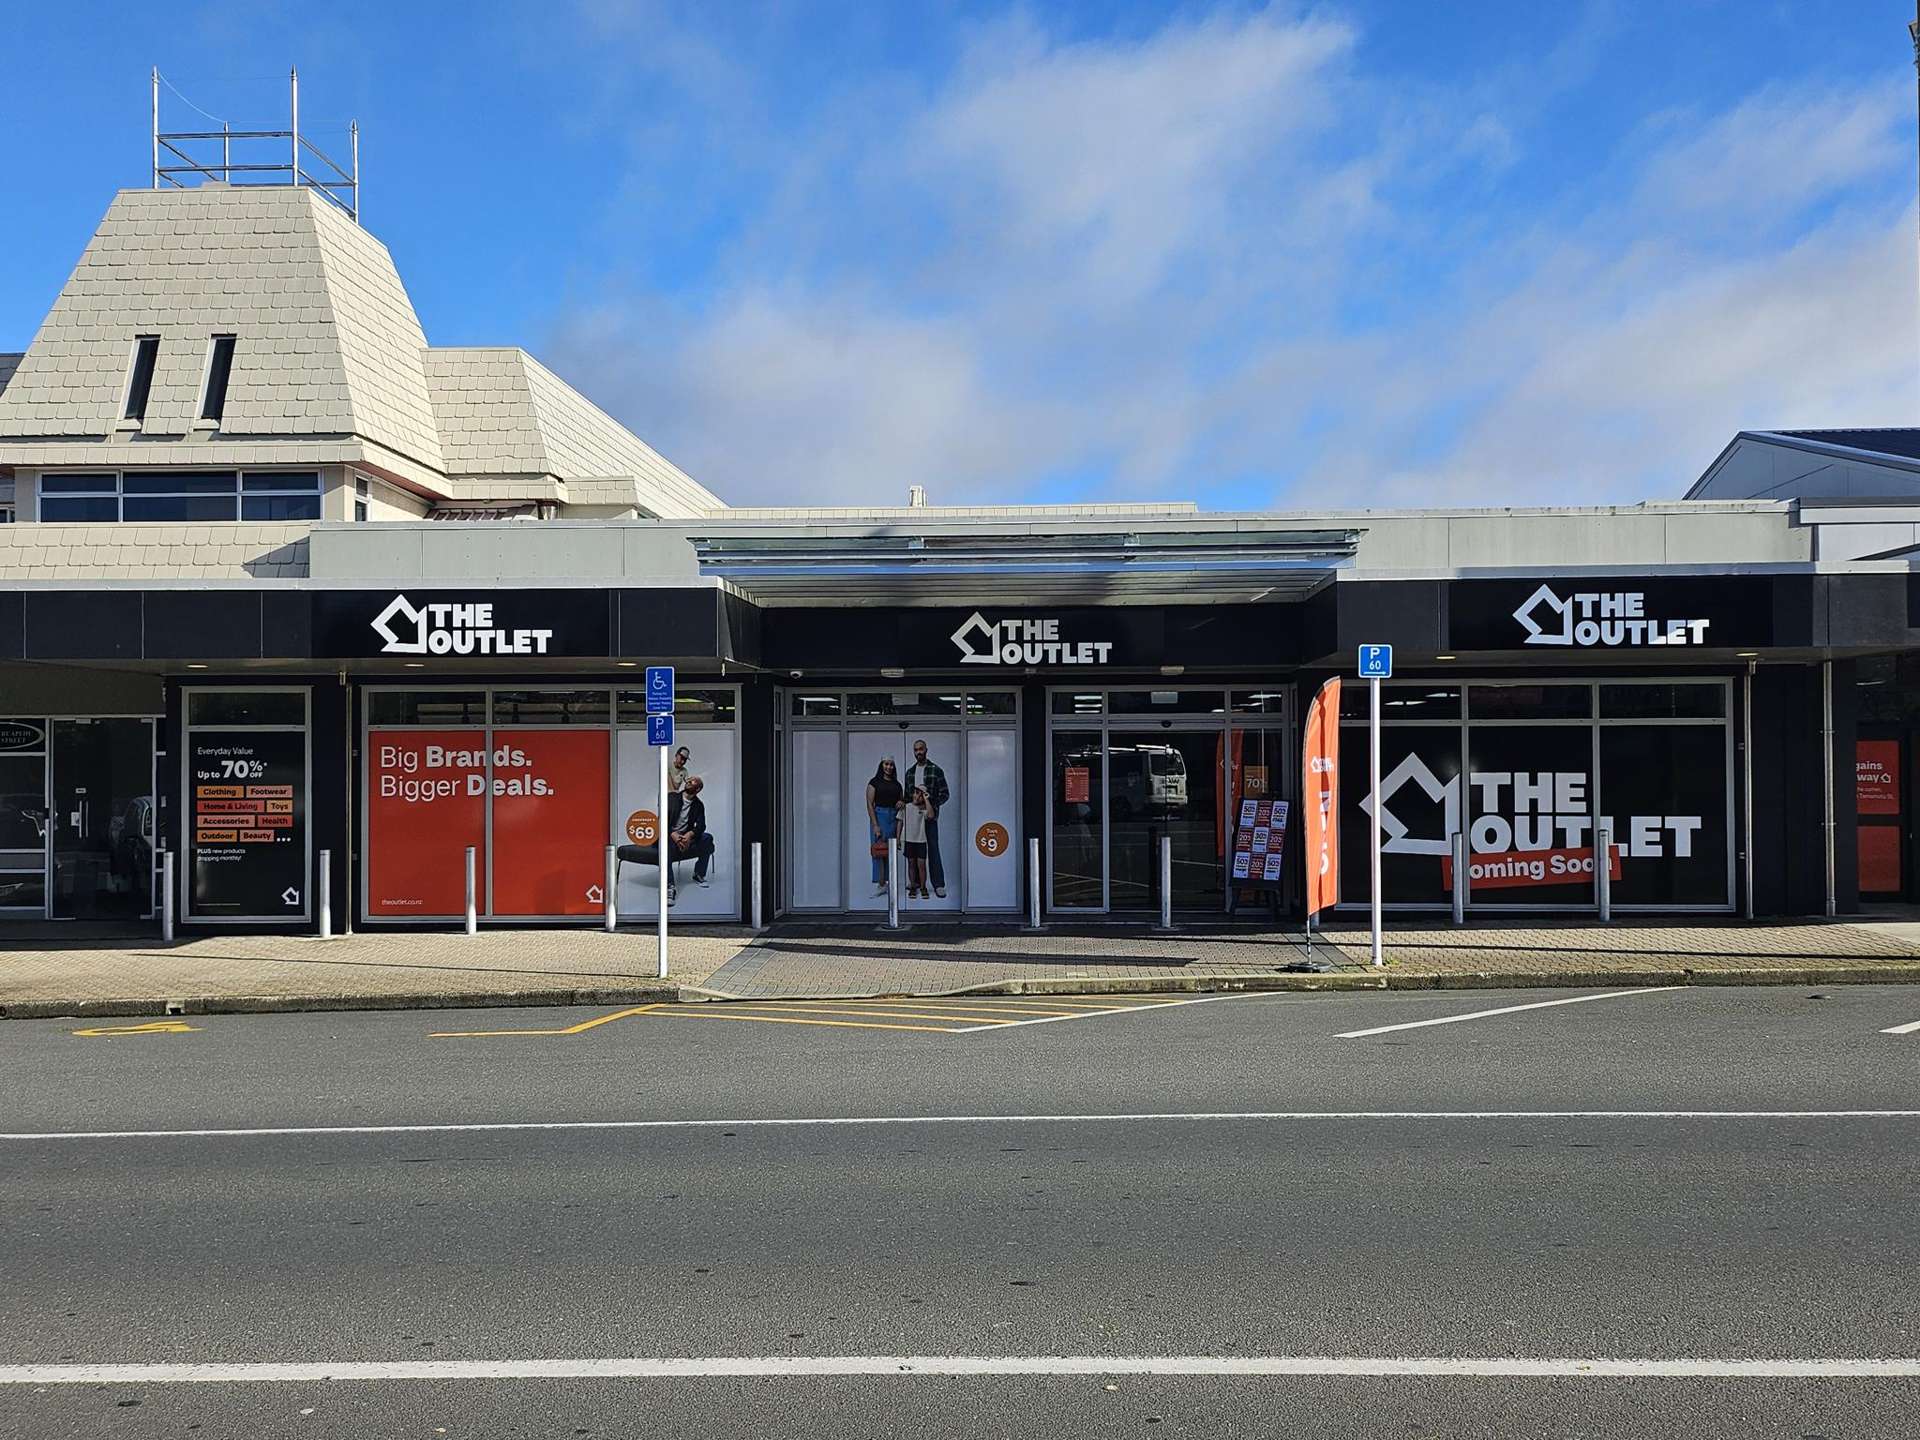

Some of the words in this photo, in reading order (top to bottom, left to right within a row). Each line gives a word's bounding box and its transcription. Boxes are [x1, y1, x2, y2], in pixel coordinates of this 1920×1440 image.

[1575, 593, 1644, 618] THE
[428, 603, 493, 628] THE
[1001, 619, 1059, 641] THE
[1575, 619, 1710, 646] OUTLET
[428, 629, 553, 655] OUTLET
[1001, 642, 1112, 665] OUTLET
[1370, 647, 1380, 660] P
[1369, 660, 1381, 670] 60
[655, 717, 664, 729] P
[655, 730, 666, 739] 60
[197, 747, 231, 756] Everyday
[232, 747, 254, 755] Value
[381, 746, 418, 773] Big
[426, 745, 533, 767] Brands.
[197, 770, 209, 780] Up
[203, 788, 237, 796] Clothing
[381, 774, 461, 802] Bigger
[466, 773, 554, 796] Deals.
[1470, 772, 1587, 813] THE
[235, 803, 258, 811] Living
[243, 832, 271, 840] Beauty
[629, 826, 655, 840] $69
[1470, 814, 1702, 857] OUTLET
[980, 837, 998, 852] $9
[1453, 858, 1545, 881] oming
